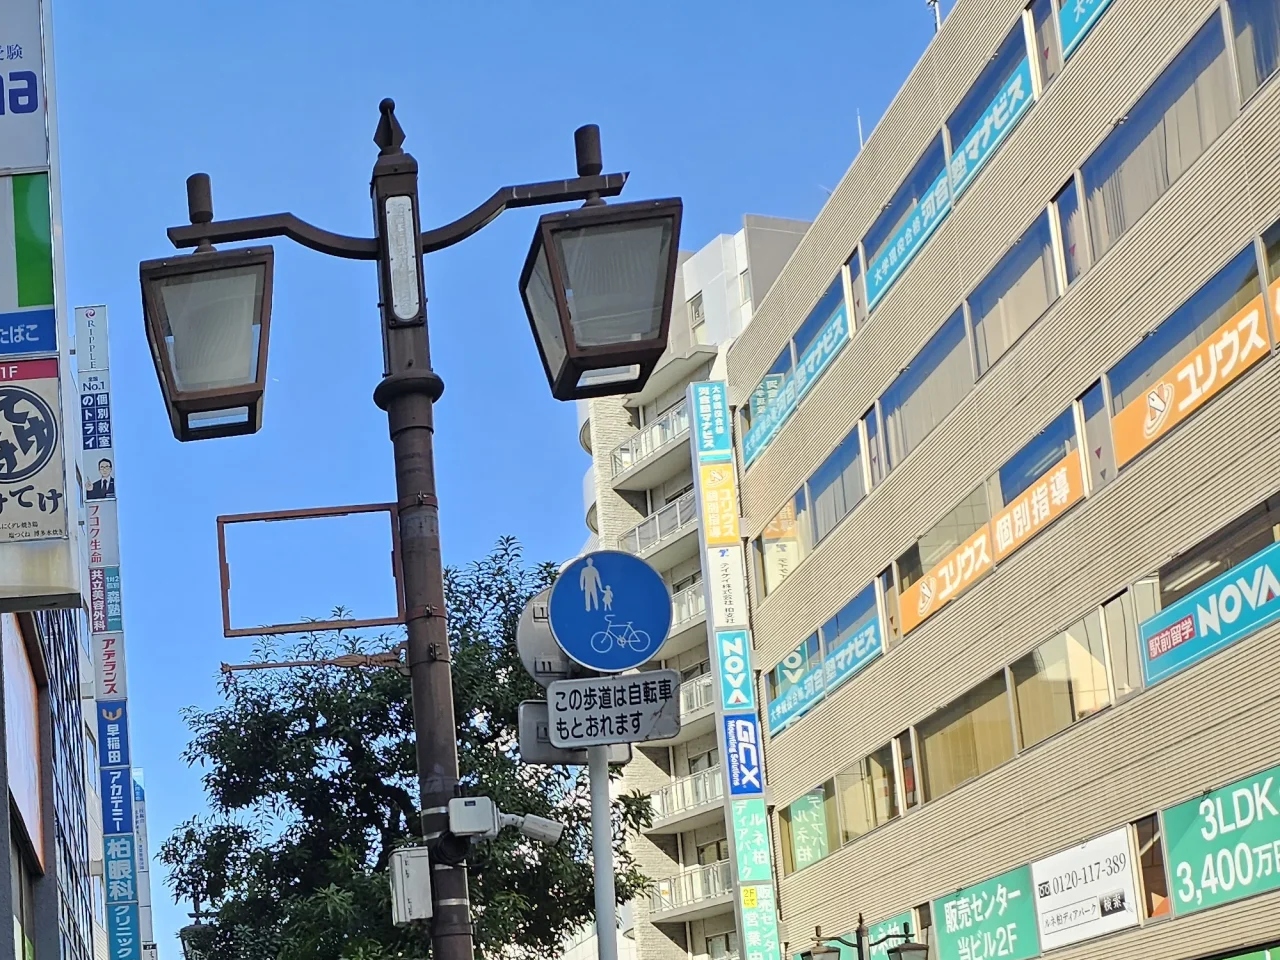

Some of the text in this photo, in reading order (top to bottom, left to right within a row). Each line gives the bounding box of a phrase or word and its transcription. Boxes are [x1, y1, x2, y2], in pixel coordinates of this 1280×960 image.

[920, 75, 1025, 231] 河合塾マナビス
[87, 320, 97, 369] RIPPLE
[1176, 308, 1266, 412] ユリウス
[82, 381, 106, 392] No.1
[82, 395, 95, 448] のトライ
[97, 394, 111, 448] 個別教室
[89, 505, 102, 563] フコク生命
[720, 489, 735, 537] ユリウス
[937, 469, 1071, 601] ユリウス 個別指導
[91, 569, 106, 631] 共立美容外科
[1148, 563, 1280, 658] 駅前留学 NOVA
[555, 679, 673, 713] この歩道は自転車
[722, 637, 750, 705] NOVA
[556, 710, 644, 740] もとおれます
[107, 724, 124, 832] 早稲田 アカデミー
[736, 719, 761, 788] GCX
[1199, 776, 1279, 840] 3LDK
[734, 801, 752, 880] ディアパーク
[749, 813, 768, 865] ルネ柏
[107, 838, 135, 901] 柏眼科
[743, 888, 755, 898] 2F
[1052, 852, 1127, 896] 0120-117-389
[114, 905, 133, 959] クリニック
[943, 883, 1021, 934] 販売センター
